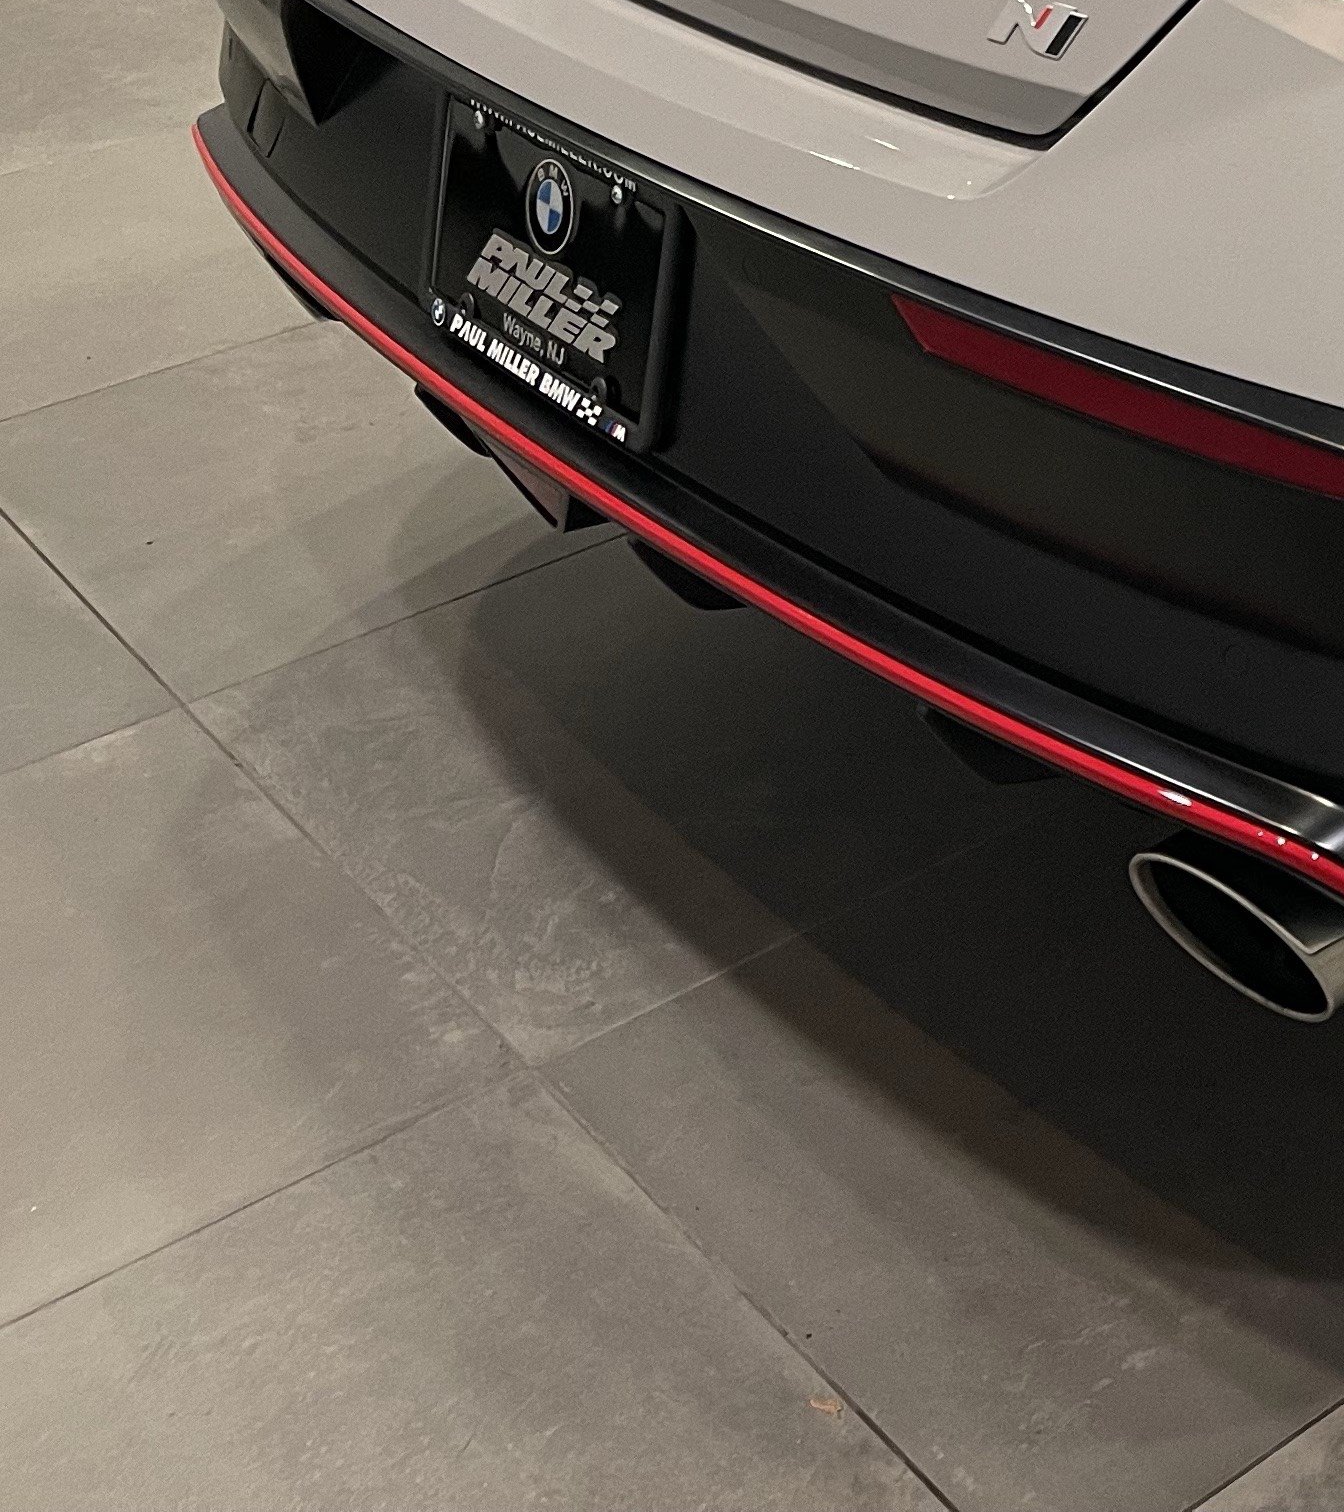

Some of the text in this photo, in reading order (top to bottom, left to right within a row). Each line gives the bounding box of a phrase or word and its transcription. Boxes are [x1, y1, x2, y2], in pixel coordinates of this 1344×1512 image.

[537, 164, 569, 196] BMW
[481, 234, 569, 304] PAUL
[467, 257, 616, 363] MILLER
[503, 312, 566, 365] Wayne, NJ
[450, 313, 581, 412] PAUL MILLER BMW
